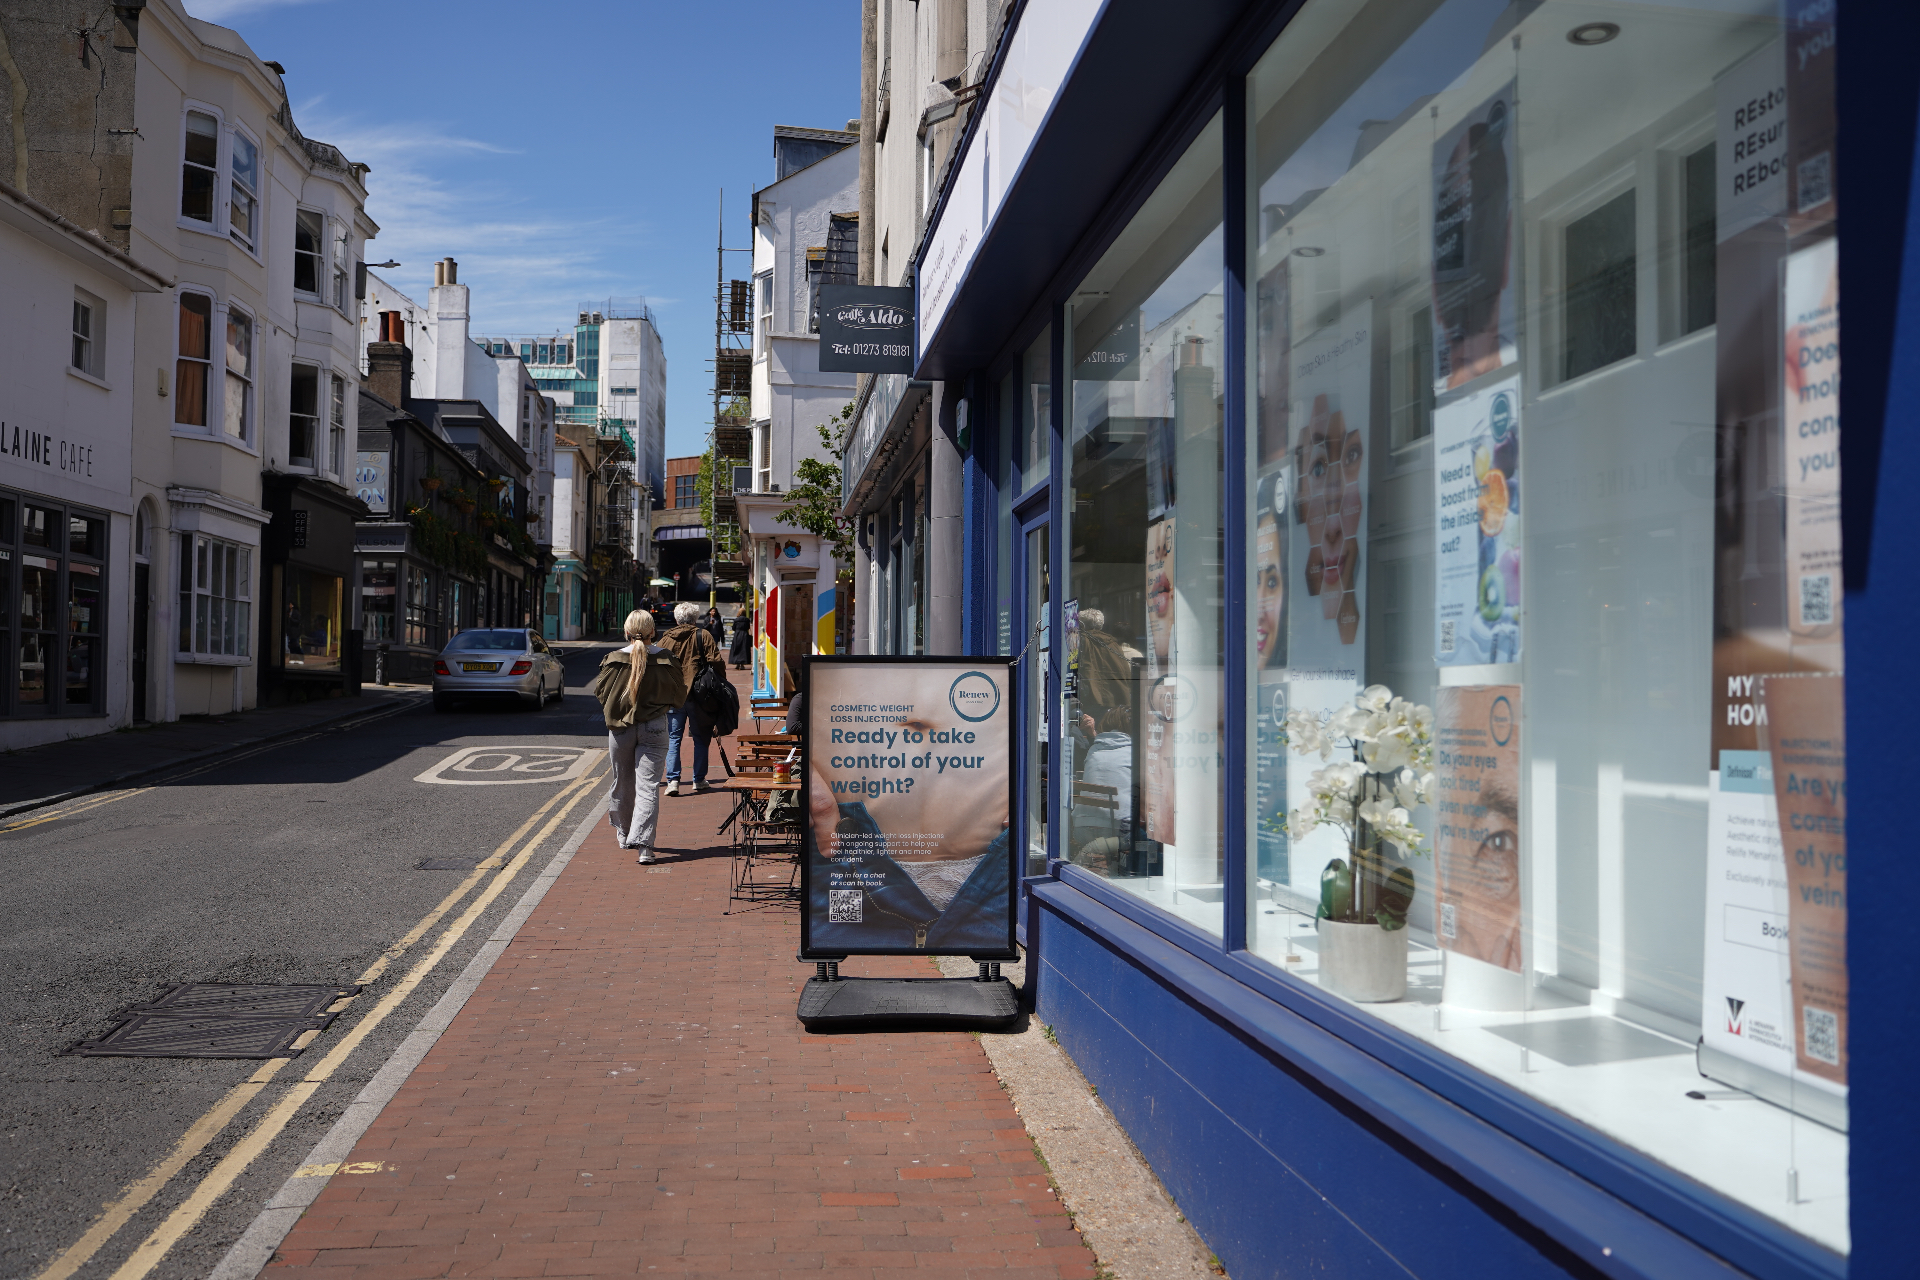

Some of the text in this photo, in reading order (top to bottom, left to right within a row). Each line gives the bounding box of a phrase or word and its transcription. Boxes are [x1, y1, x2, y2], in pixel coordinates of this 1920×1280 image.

[1438, 178, 1472, 210] Noticing
[1434, 202, 1472, 237] thinning
[1435, 232, 1457, 259] hair?
[867, 308, 904, 325] Aldo
[831, 343, 910, 357] Tel: 01273 819181
[1314, 353, 1326, 369] Skin
[1332, 338, 1354, 358] Healthy
[1354, 329, 1367, 346] Skin
[0, 421, 93, 478] LAINE CAFÉ
[1440, 463, 1471, 484] Need a
[1441, 482, 1490, 507] boost from
[1441, 507, 1484, 531] the inside
[1441, 536, 1460, 554] out?
[1291, 668, 1302, 682] Get
[1302, 669, 1316, 684] your
[1316, 667, 1327, 681] skin
[1334, 667, 1356, 684] shape
[1727, 675, 1754, 697] MY
[958, 690, 990, 699] Renew
[830, 704, 915, 713] COSMETIC WEIGHT
[830, 715, 908, 723] LOSS INJECTIONS
[831, 727, 976, 749] Ready to take
[453, 753, 579, 772] 20
[830, 751, 985, 774] control of your
[1439, 750, 1498, 774] Do your eyes
[830, 775, 915, 799] weight?
[1439, 772, 1481, 792] look tired
[1787, 773, 1823, 797] Are
[1439, 799, 1488, 818] even when
[874, 832, 897, 841] weight
[1438, 822, 1490, 843] you're not?
[1726, 830, 1761, 844] Aesthetic
[844, 848, 875, 856] healthier,
[876, 848, 897, 856] lighter
[845, 840, 874, 849] ongoing
[874, 841, 901, 849] support
[910, 840, 926, 849] help
[1794, 844, 1815, 869] of
[1725, 870, 1765, 887] Exclusively
